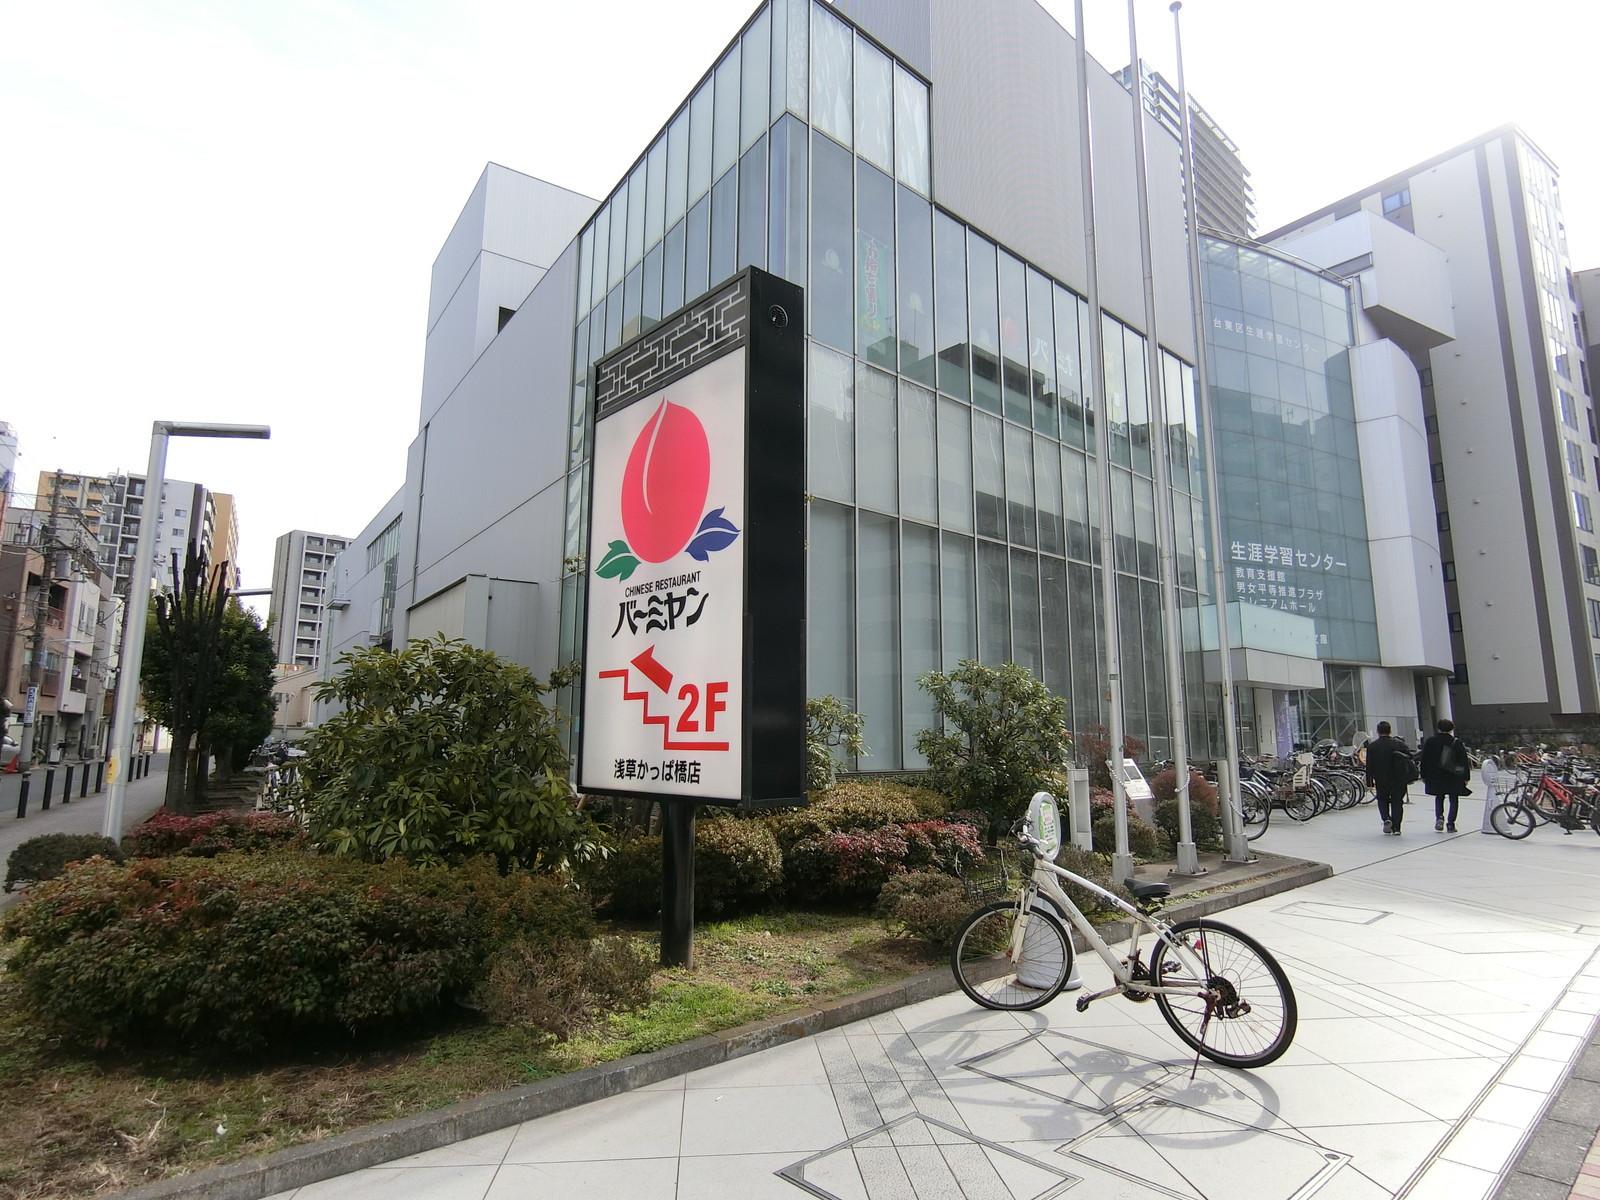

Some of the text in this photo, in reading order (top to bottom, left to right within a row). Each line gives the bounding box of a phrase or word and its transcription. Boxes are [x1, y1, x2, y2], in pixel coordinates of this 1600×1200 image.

[1231, 542, 1347, 570] 生涯学習センター
[625, 571, 701, 598] CHINESE RESTAURANT
[1235, 567, 1286, 582] 教育支援館
[1236, 582, 1323, 600] 男女平等推進プラザ
[1238, 596, 1315, 612] ミレニアムホール
[611, 587, 709, 638] バーミヤン
[676, 681, 728, 732] 2F
[614, 758, 701, 784] 浅草かっぱ橋店
